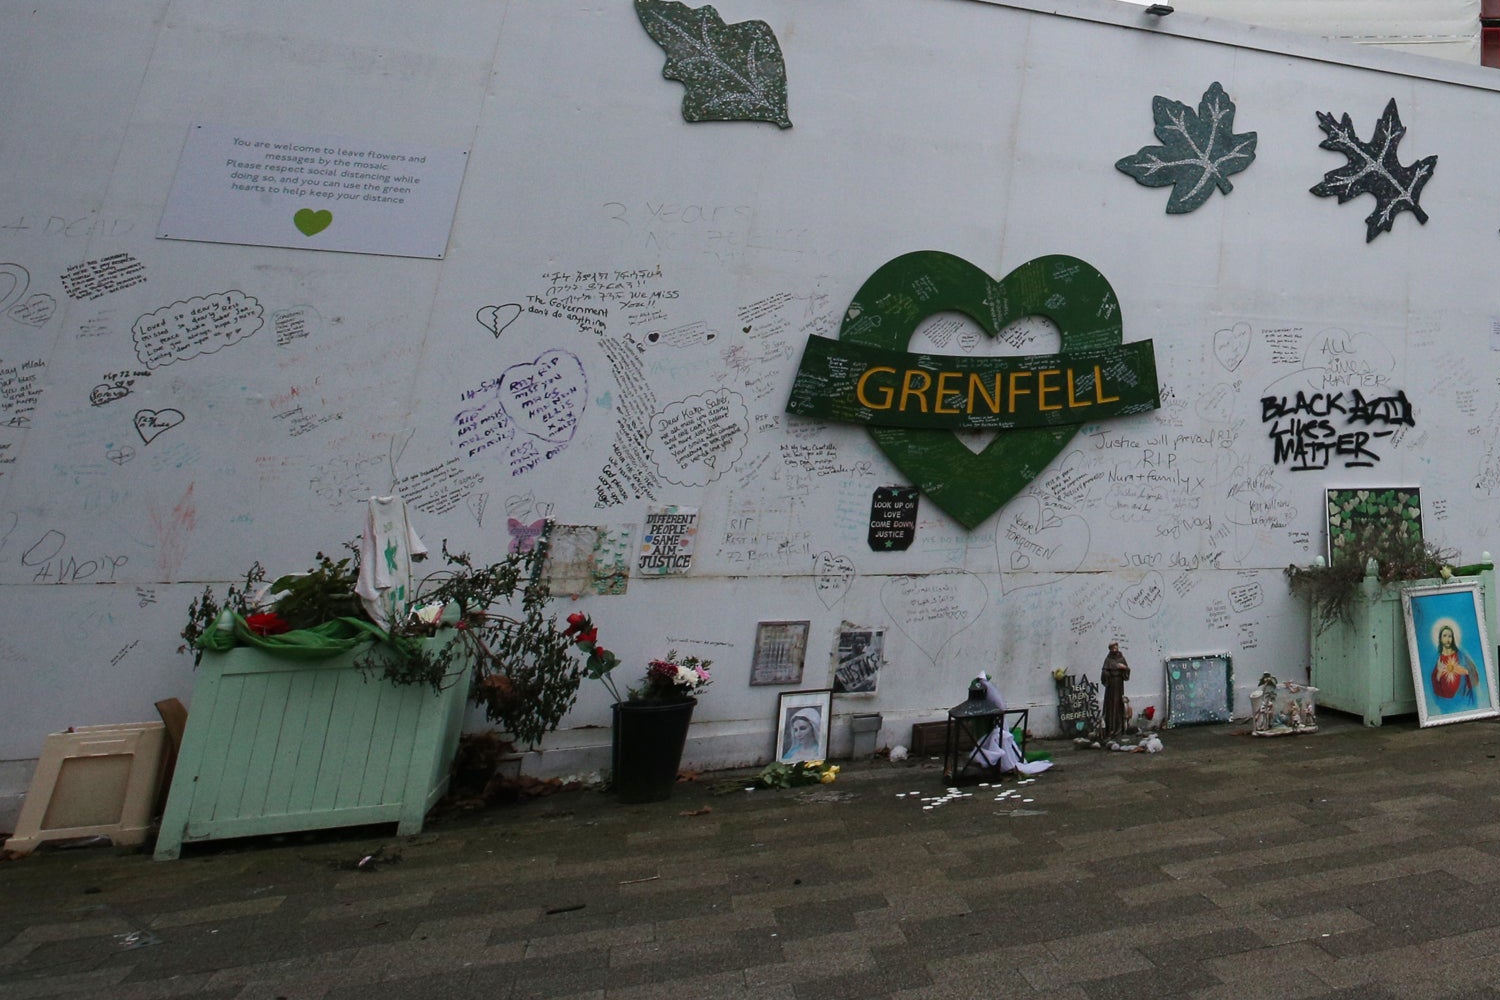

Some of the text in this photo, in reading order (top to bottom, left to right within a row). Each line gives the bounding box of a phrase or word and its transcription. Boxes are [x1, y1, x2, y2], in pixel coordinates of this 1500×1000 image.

[232, 137, 427, 164] You are welcome to leave flowers and
[265, 152, 315, 165] messages
[318, 156, 331, 167] by
[333, 158, 351, 167] the
[226, 159, 421, 185] Please respect social distancing while
[230, 171, 411, 195] doing so, and you can use the green
[231, 182, 405, 204] hearts to help keep your distance
[525, 295, 548, 306] The
[549, 298, 609, 318] Government
[551, 310, 563, 319] do
[139, 318, 166, 335] Loved
[1320, 336, 1359, 355] ALL
[856, 363, 1121, 416] GRENFELL
[1321, 373, 1392, 390] MATTER
[1260, 390, 1347, 424] BLACK
[658, 414, 680, 432] Dear
[1088, 429, 1140, 450] Justice
[1146, 433, 1169, 447] will
[1273, 430, 1381, 468] MATTER
[1142, 448, 1177, 469] RIP
[874, 501, 892, 510] LOOK
[894, 501, 904, 509] UP
[646, 513, 697, 524] DIFFERENT
[870, 520, 891, 529] COME
[651, 534, 681, 546] SAME
[874, 530, 905, 539] JUSTICE
[638, 554, 692, 569] JUSTICE
